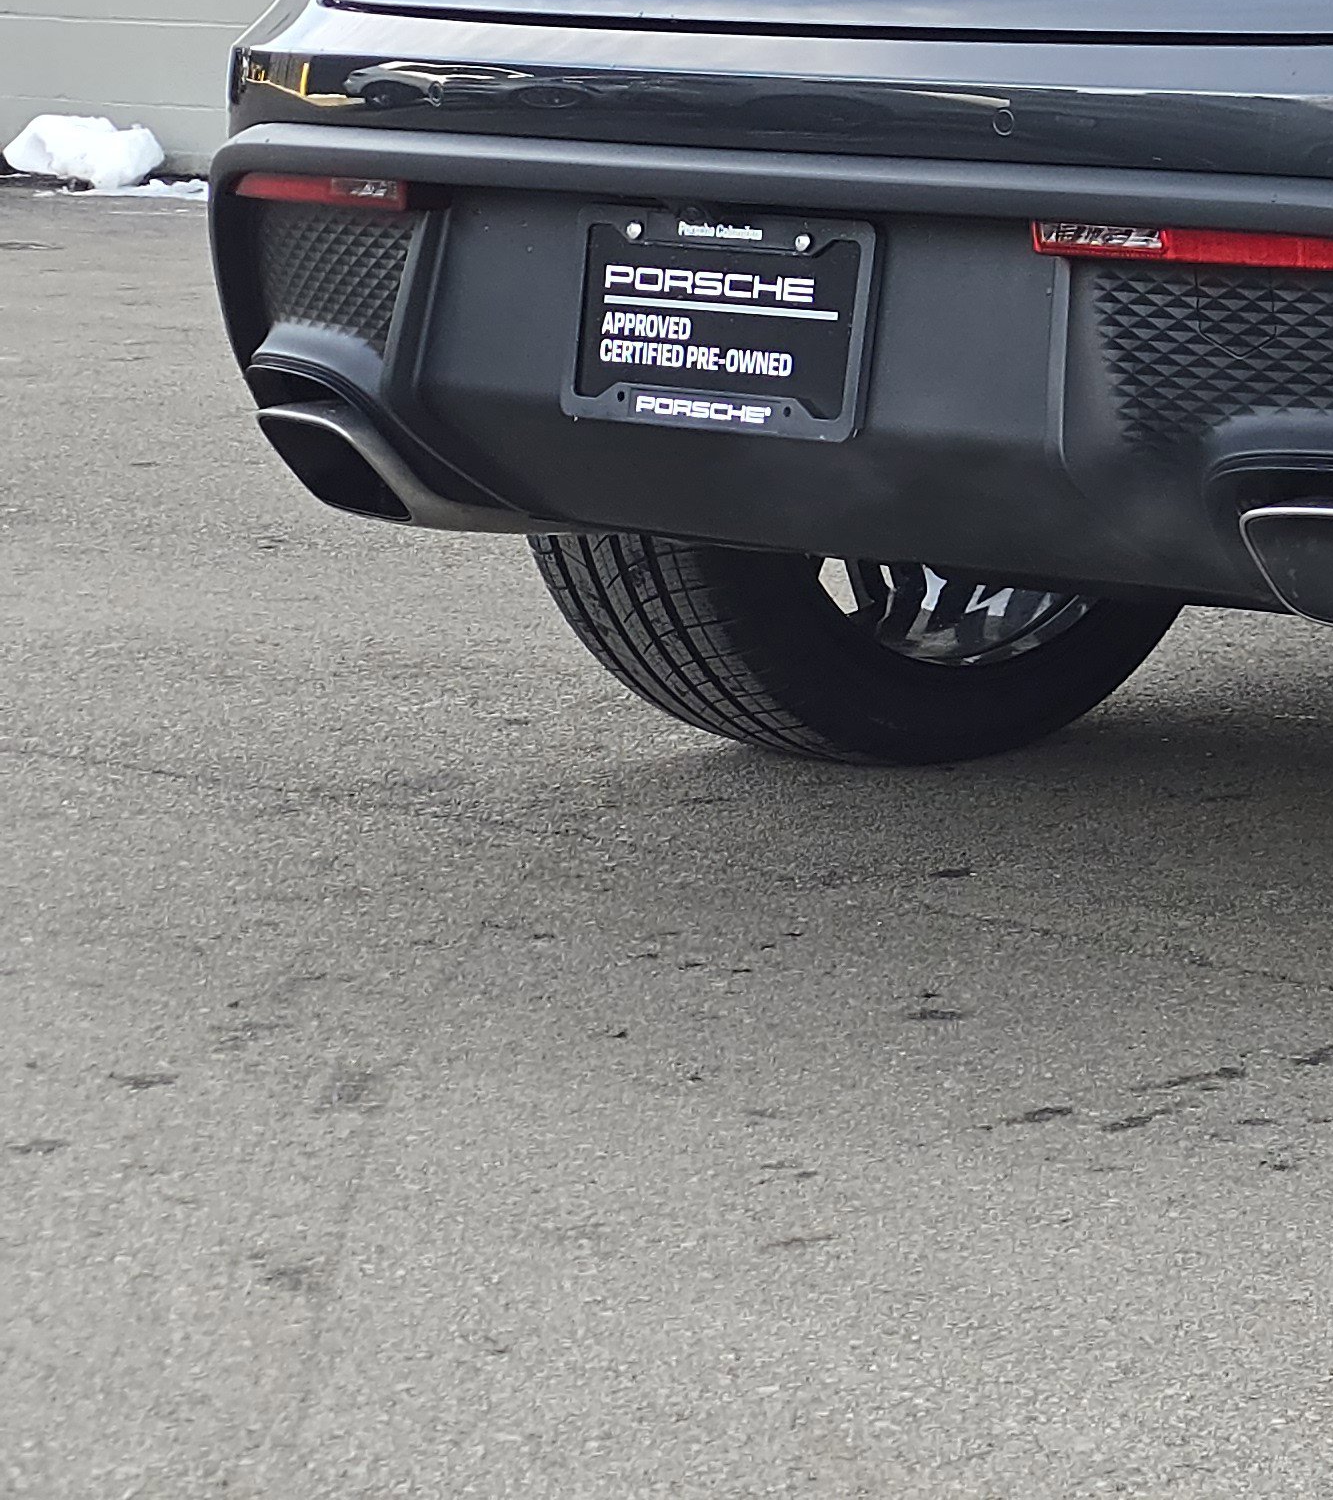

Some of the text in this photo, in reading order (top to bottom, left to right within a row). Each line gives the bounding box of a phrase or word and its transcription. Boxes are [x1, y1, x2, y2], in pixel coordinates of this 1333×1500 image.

[604, 264, 815, 303] PORSCHE
[601, 311, 692, 340] APPROVED
[599, 338, 793, 377] CERTIFIED PRE-OWNED
[635, 395, 767, 424] PORSCHE
